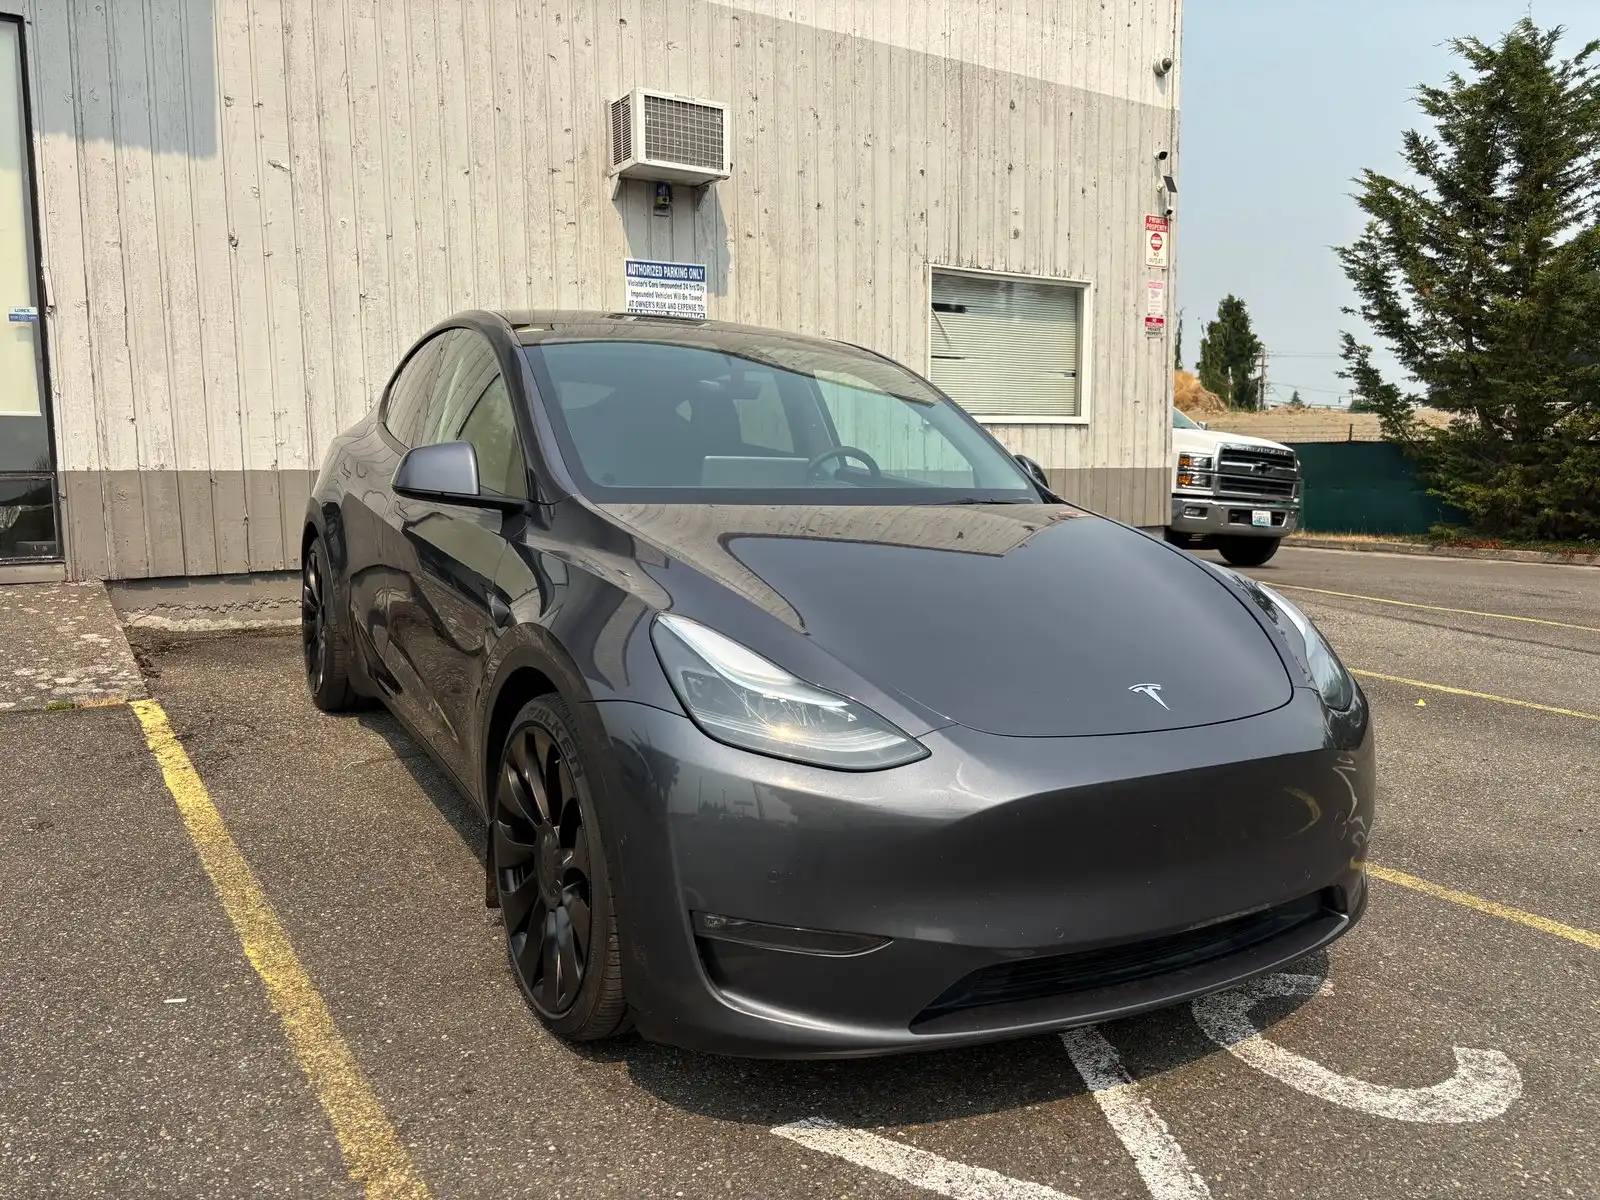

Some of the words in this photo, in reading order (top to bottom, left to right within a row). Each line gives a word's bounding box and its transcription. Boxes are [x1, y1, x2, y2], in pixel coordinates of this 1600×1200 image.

[1146, 223, 1168, 232] PROPERTY
[628, 263, 662, 277] AUTHORIZED
[663, 266, 688, 279] PARKING
[688, 267, 704, 280] ONLY
[648, 281, 659, 289] Cars
[659, 282, 683, 291] Impounded
[631, 290, 654, 299] Impounded
[655, 291, 673, 299] Vehicles
[682, 293, 688, 301] Be
[667, 302, 677, 310] AND
[678, 304, 697, 312] EXPENSE
